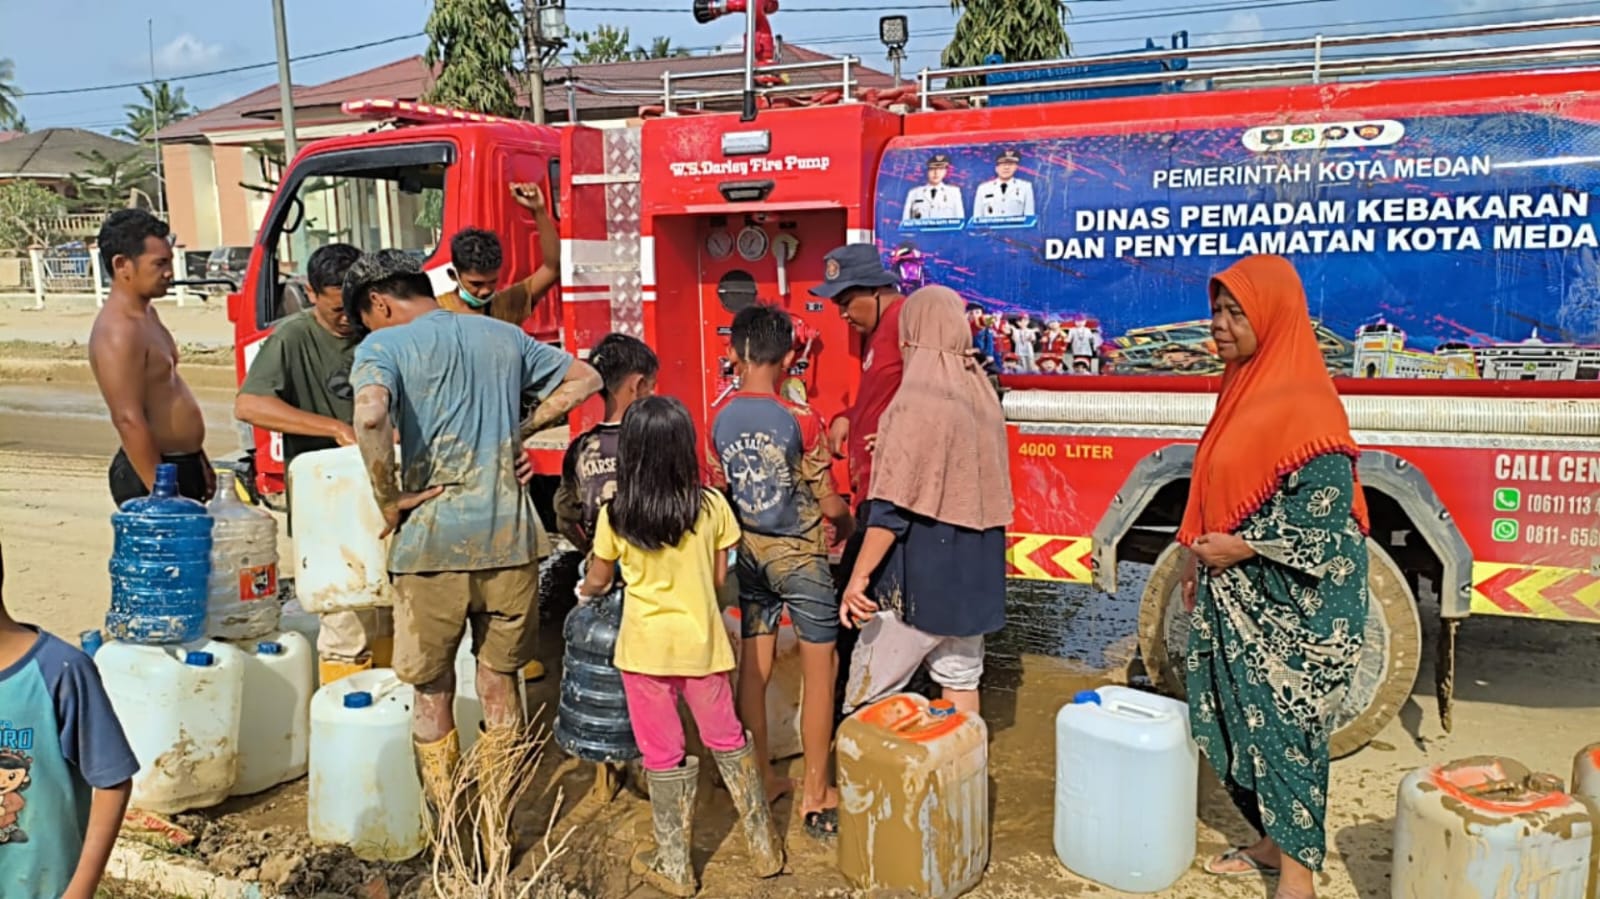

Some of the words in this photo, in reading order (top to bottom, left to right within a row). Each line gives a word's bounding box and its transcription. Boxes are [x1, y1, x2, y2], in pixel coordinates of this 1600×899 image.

[749, 157, 783, 173] Fire
[784, 155, 830, 171] Pump
[1152, 163, 1311, 189] PEMERINTAH
[1318, 159, 1387, 182] KOTA
[1394, 154, 1491, 180] MEDAN
[1075, 205, 1169, 232] DINAS
[1181, 201, 1345, 229] PEMADAM
[1356, 192, 1589, 224] KEBAKARAN
[1045, 238, 1104, 261] DAN
[1115, 228, 1375, 257] PENYELAMATAN
[1387, 226, 1482, 251] KOTA
[1493, 223, 1598, 250] MEDA
[1018, 442, 1056, 457] 4000
[1065, 443, 1113, 459] LITER
[1495, 453, 1552, 481] CALL
[1568, 495, 1591, 515] 113
[1525, 524, 1559, 545] 0811
